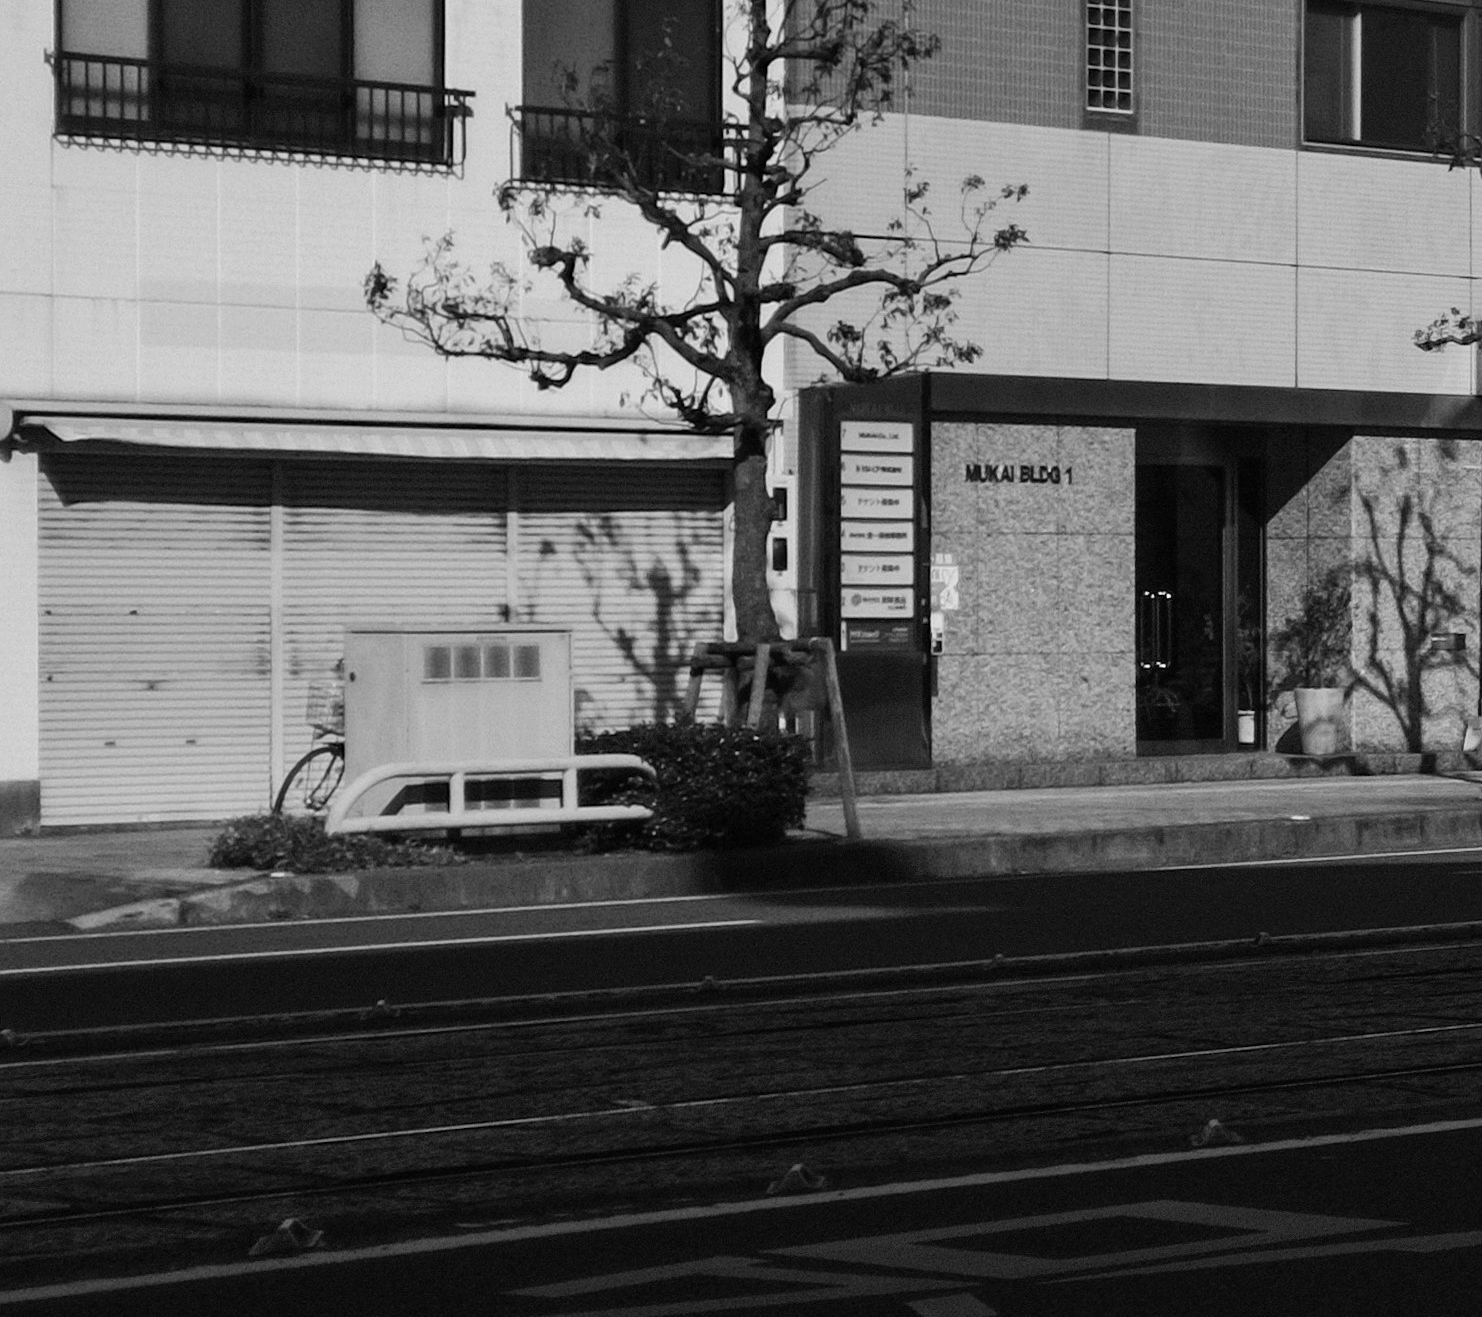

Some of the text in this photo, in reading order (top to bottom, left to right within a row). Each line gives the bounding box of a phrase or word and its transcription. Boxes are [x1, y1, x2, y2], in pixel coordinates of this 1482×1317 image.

[965, 463, 1073, 486] MUKAI BLDG 1
